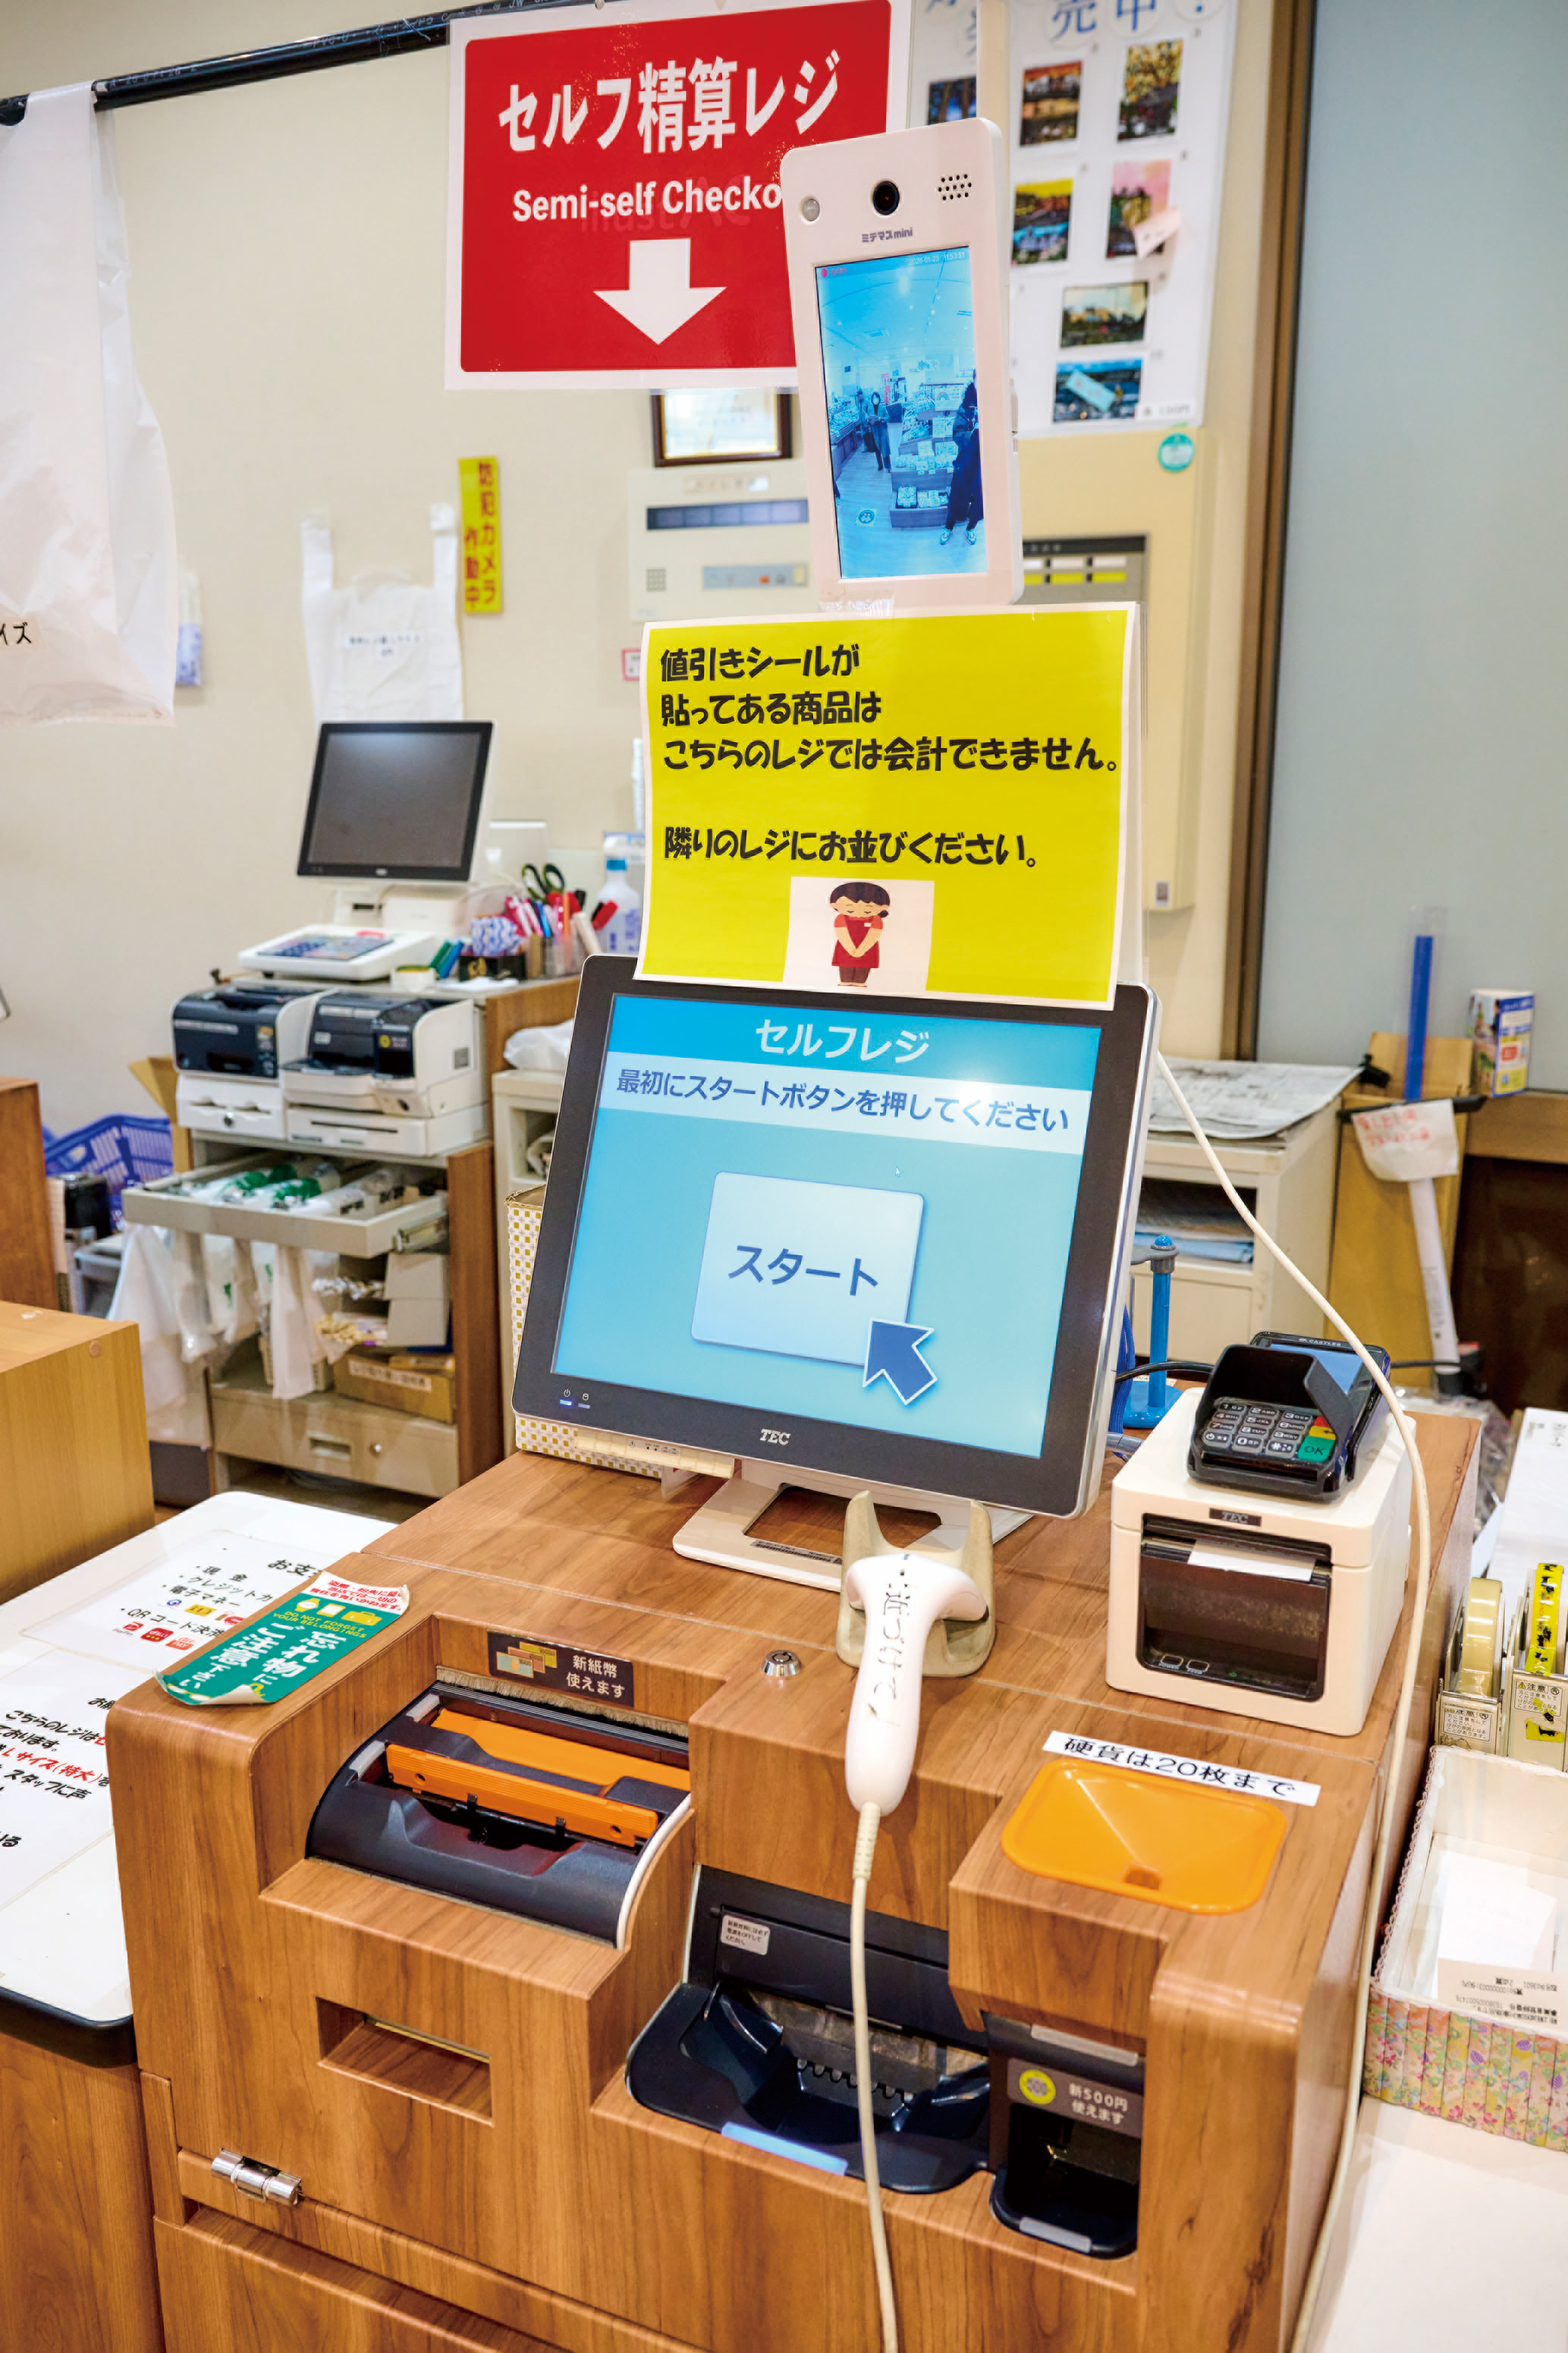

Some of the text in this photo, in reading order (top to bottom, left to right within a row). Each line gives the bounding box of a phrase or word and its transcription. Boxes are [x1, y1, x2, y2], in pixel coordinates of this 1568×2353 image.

[498, 49, 841, 153] セルフ精算レジ
[513, 181, 657, 222] Semi-self
[862, 227, 913, 243] ミテマスmini
[910, 251, 966, 266] 2026-01-23 11:53:51
[661, 643, 860, 681] 値引きシールが
[661, 690, 882, 727] 貼ってある商品は
[664, 735, 1117, 772] こちらのレジでは会計できません。
[665, 826, 1037, 868] 隣りのレジにお並びください。
[756, 1018, 931, 1065] セルフレジ
[616, 1068, 1070, 1134] 最初にスタートボタンを押してください
[727, 1244, 879, 1297] スタート
[1308, 1339, 1342, 1347] CASTLES
[759, 1428, 791, 1445] TEC
[1304, 1445, 1324, 1455] OK
[1221, 1511, 1249, 1524] TEC
[268, 1559, 319, 1578] お支
[273, 1612, 367, 1638] YOUR BELONGINGS
[300, 1614, 322, 1622] NOT
[322, 1620, 365, 1632] FORGET
[253, 1631, 347, 1685] 忘れ物に
[573, 1655, 617, 1678] 新紙幣
[566, 1672, 625, 1699] 使えます
[1064, 1736, 1296, 1797] 硬貨は20枚まで
[1068, 2082, 1129, 2112] 新500円
[1071, 2098, 1125, 2125] 使えます
